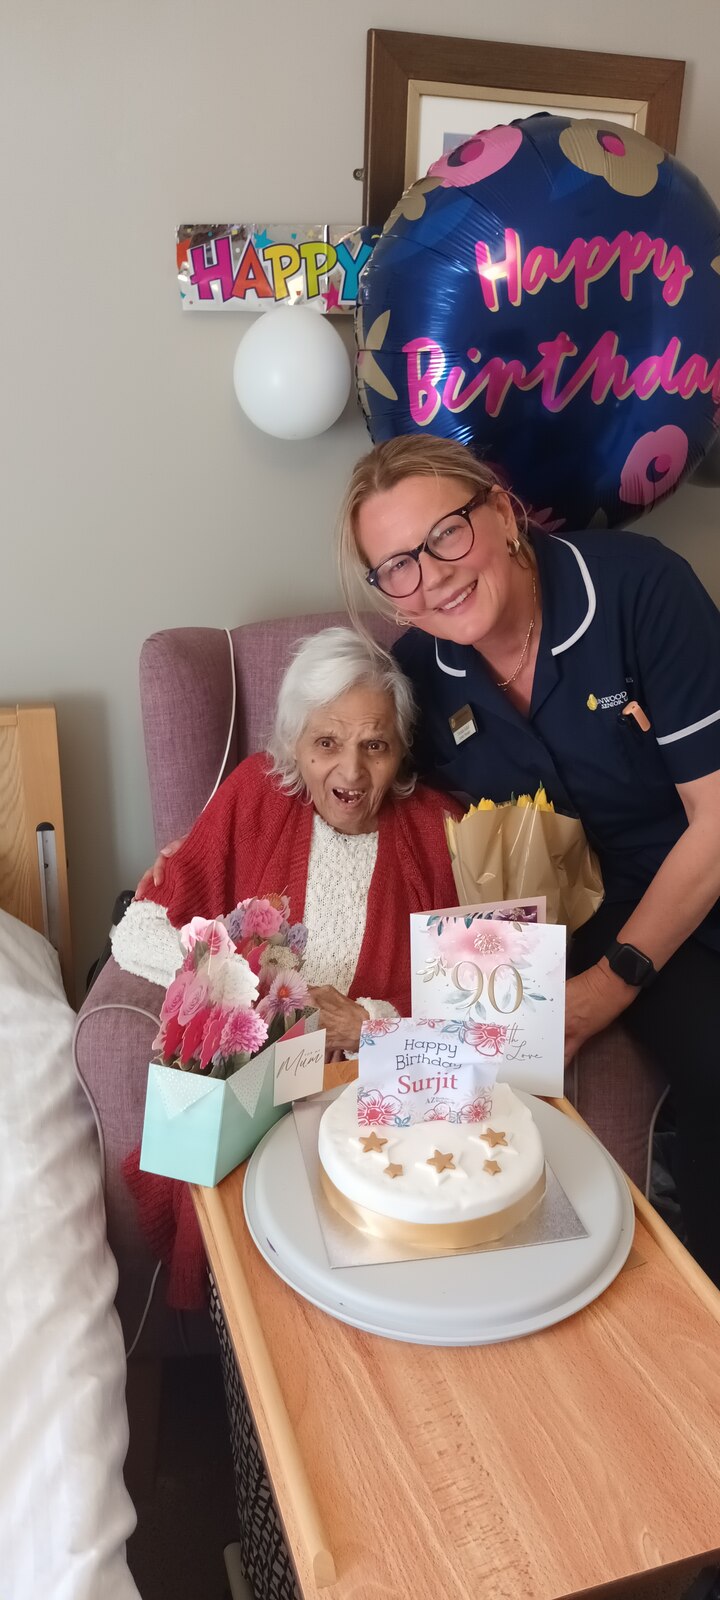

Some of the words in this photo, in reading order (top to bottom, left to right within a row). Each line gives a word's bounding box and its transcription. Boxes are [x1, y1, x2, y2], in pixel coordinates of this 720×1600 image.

[190, 236, 374, 302] HAPPY
[475, 228, 693, 312] Happy
[451, 961, 524, 1014] 90
[395, 1053, 462, 1070] Birthday
[404, 1039, 458, 1058] Happy
[505, 1040, 543, 1061] Love
[276, 1048, 323, 1079] Mum
[397, 1071, 458, 1095] Surjit
